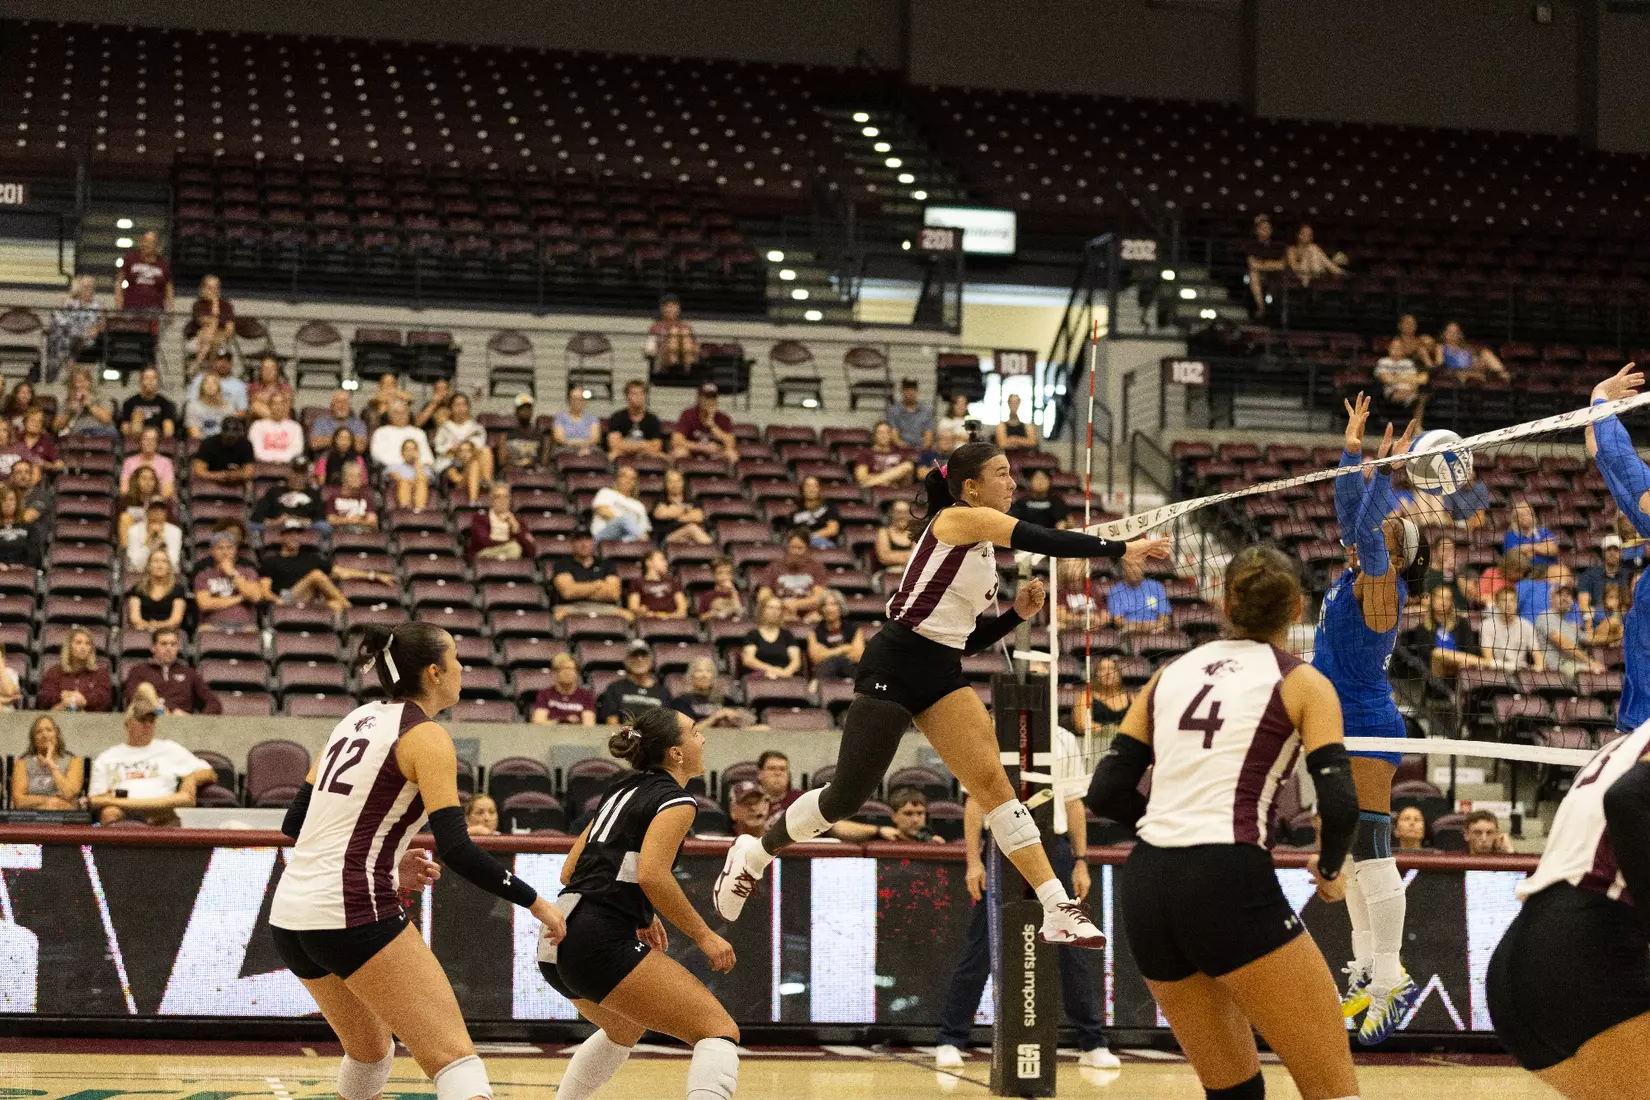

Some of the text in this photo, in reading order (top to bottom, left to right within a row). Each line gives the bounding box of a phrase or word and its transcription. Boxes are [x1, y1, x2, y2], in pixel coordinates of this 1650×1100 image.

[1001, 353, 1028, 375] 101
[1172, 361, 1204, 383] 102
[1178, 684, 1225, 749] 4
[318, 736, 371, 796] 12
[588, 786, 639, 844] 11
[1022, 924, 1037, 1027] sports imports
